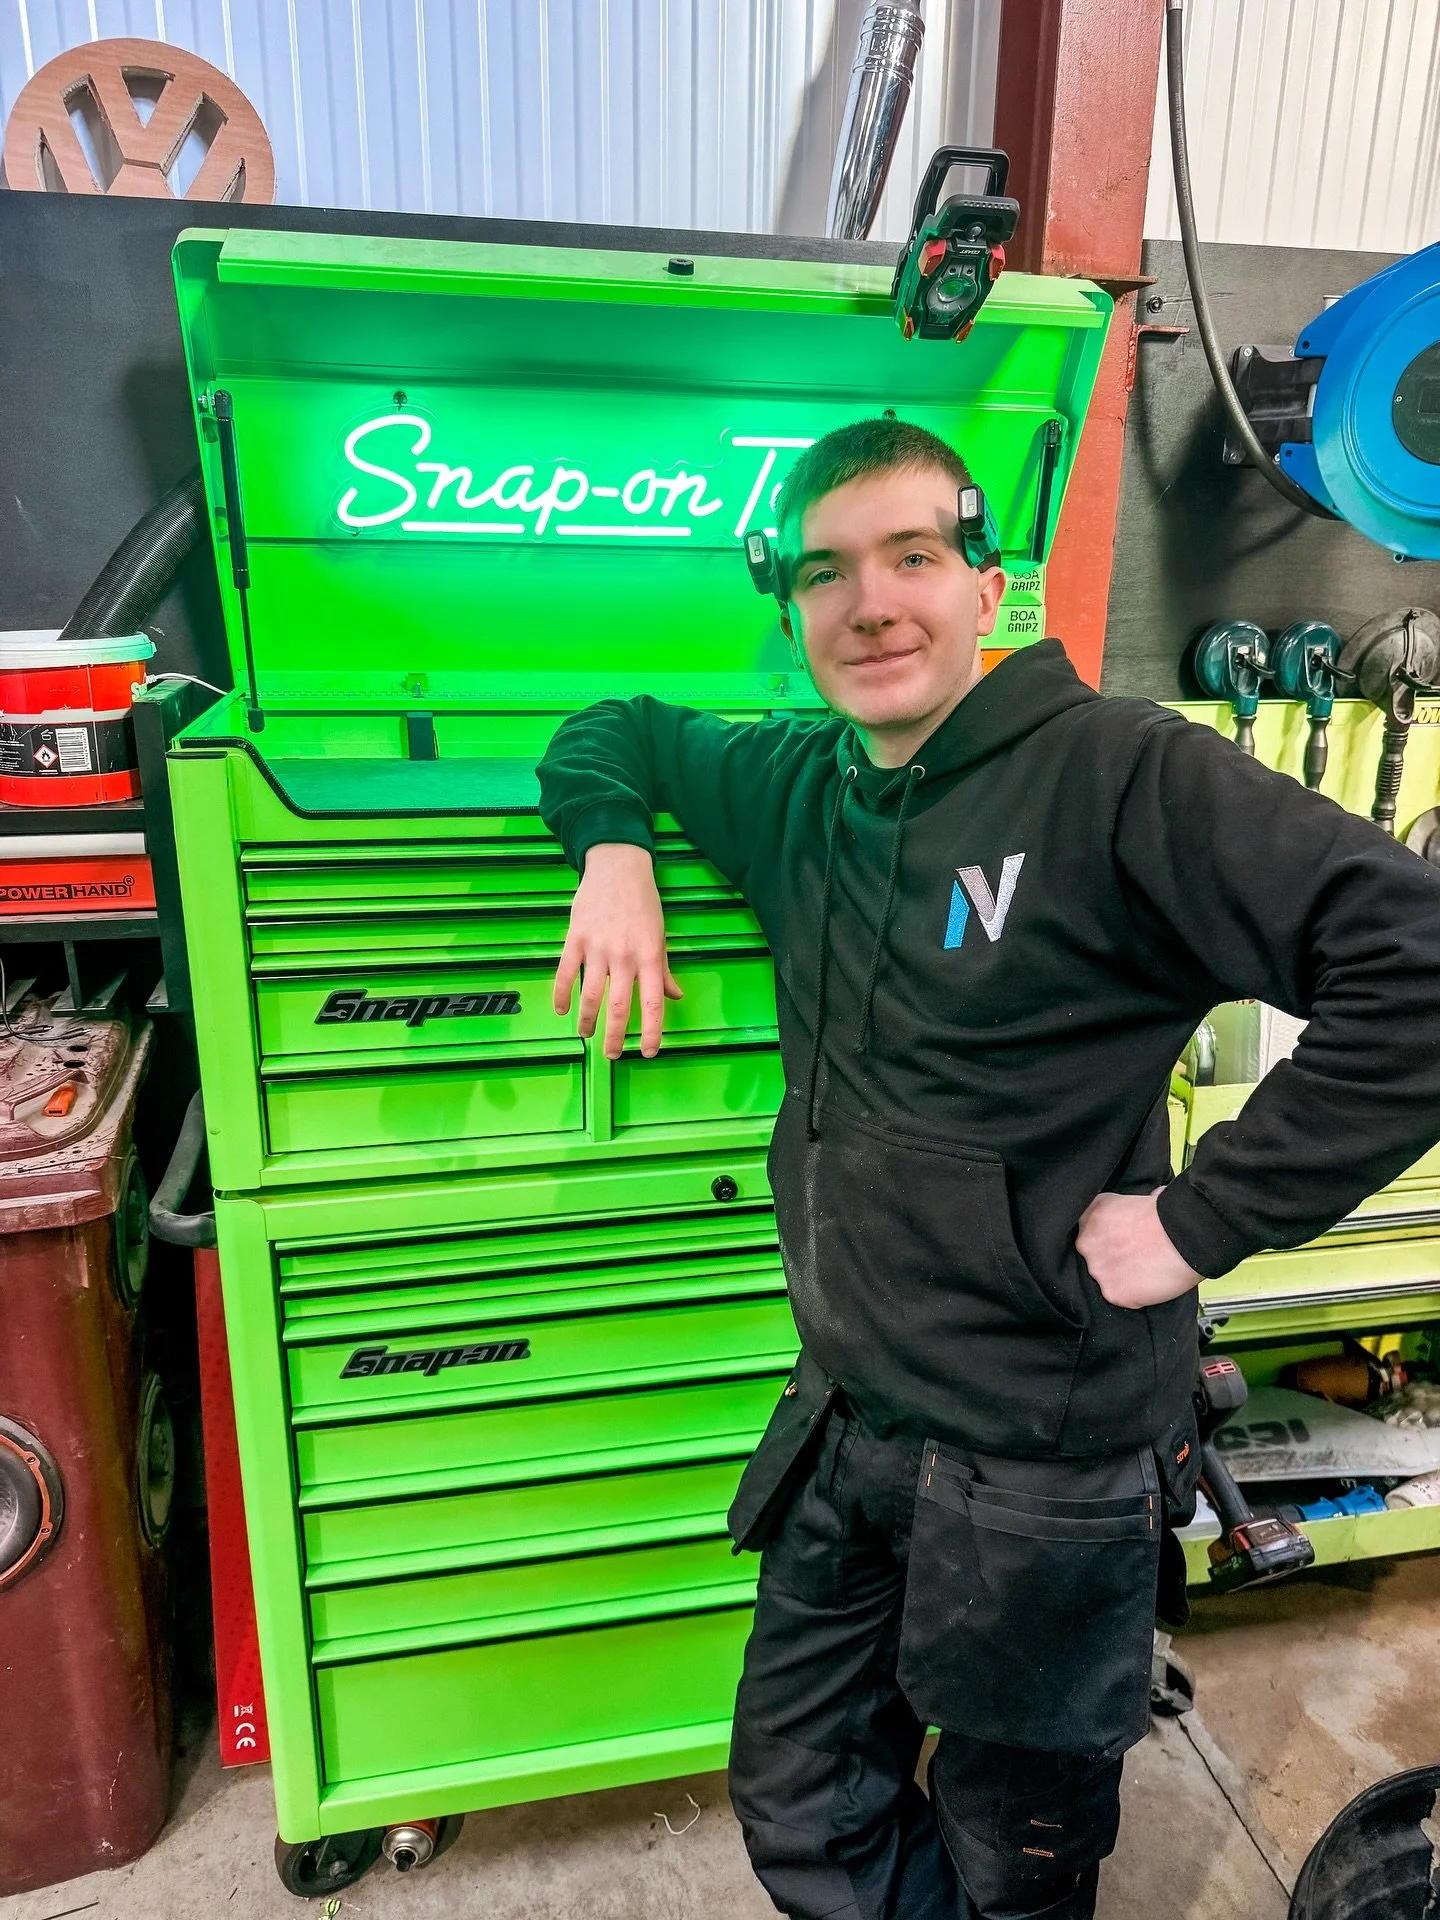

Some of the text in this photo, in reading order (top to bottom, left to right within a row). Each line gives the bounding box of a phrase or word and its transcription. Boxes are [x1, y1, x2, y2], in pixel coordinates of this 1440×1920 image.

[337, 414, 817, 538] Snap-on T
[1011, 581, 1040, 591] GRIPZ
[1007, 622, 1038, 632] GRIPZ
[1010, 610, 1036, 621] BOA
[316, 989, 520, 1027] Snap-on
[340, 1340, 530, 1377] Snap-on
